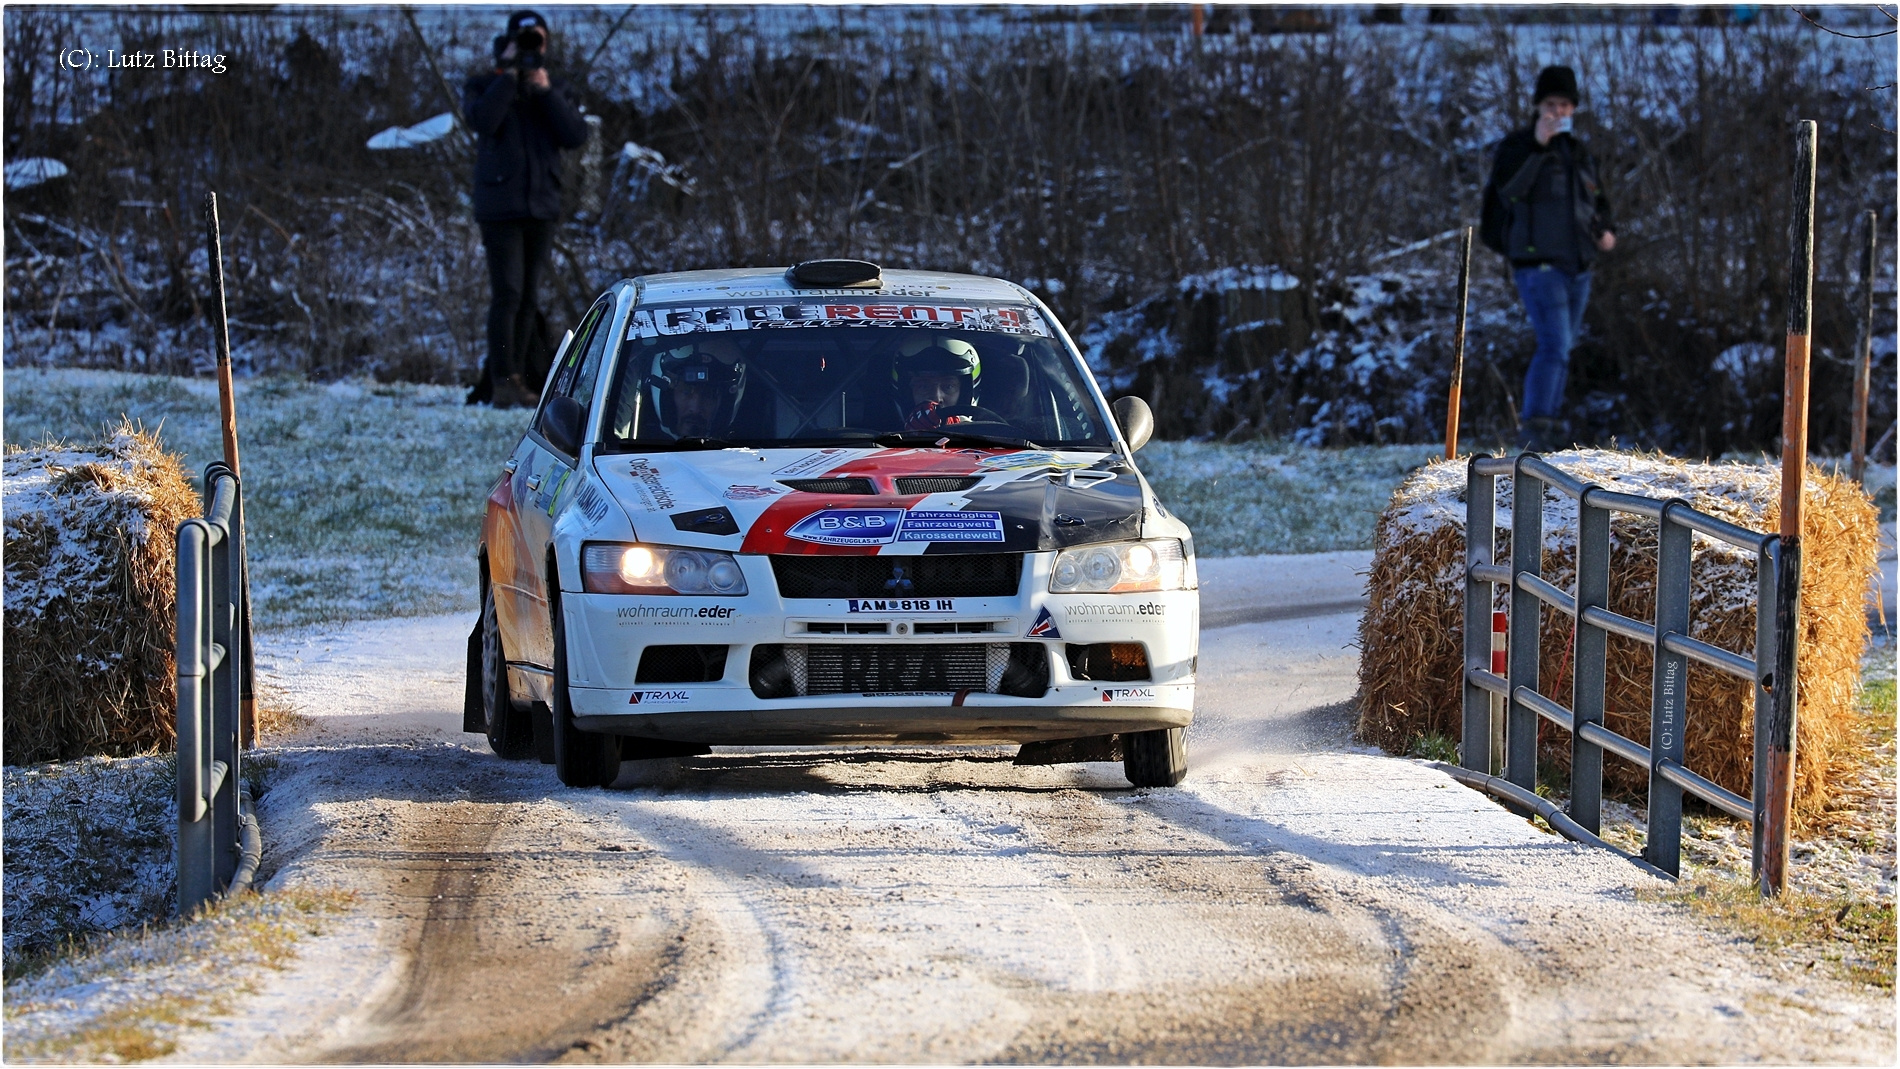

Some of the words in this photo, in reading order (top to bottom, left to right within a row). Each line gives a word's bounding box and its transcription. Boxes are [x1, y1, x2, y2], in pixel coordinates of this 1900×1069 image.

[910, 510, 994, 519] Fahrzeugglas
[818, 514, 887, 530] B&B
[906, 520, 991, 529] Fahrzeugwelt
[802, 533, 880, 544] www.FAHRZEUGGLAS.at
[903, 531, 998, 541] Karosseriewelt
[860, 600, 887, 611] AM
[900, 599, 931, 611] 818
[936, 599, 953, 611] IH
[1064, 601, 1167, 616] wohnraum.eder
[617, 603, 736, 619] wohnraum.eder
[644, 690, 690, 700] TRAXL
[1113, 688, 1155, 698] TRAXL
